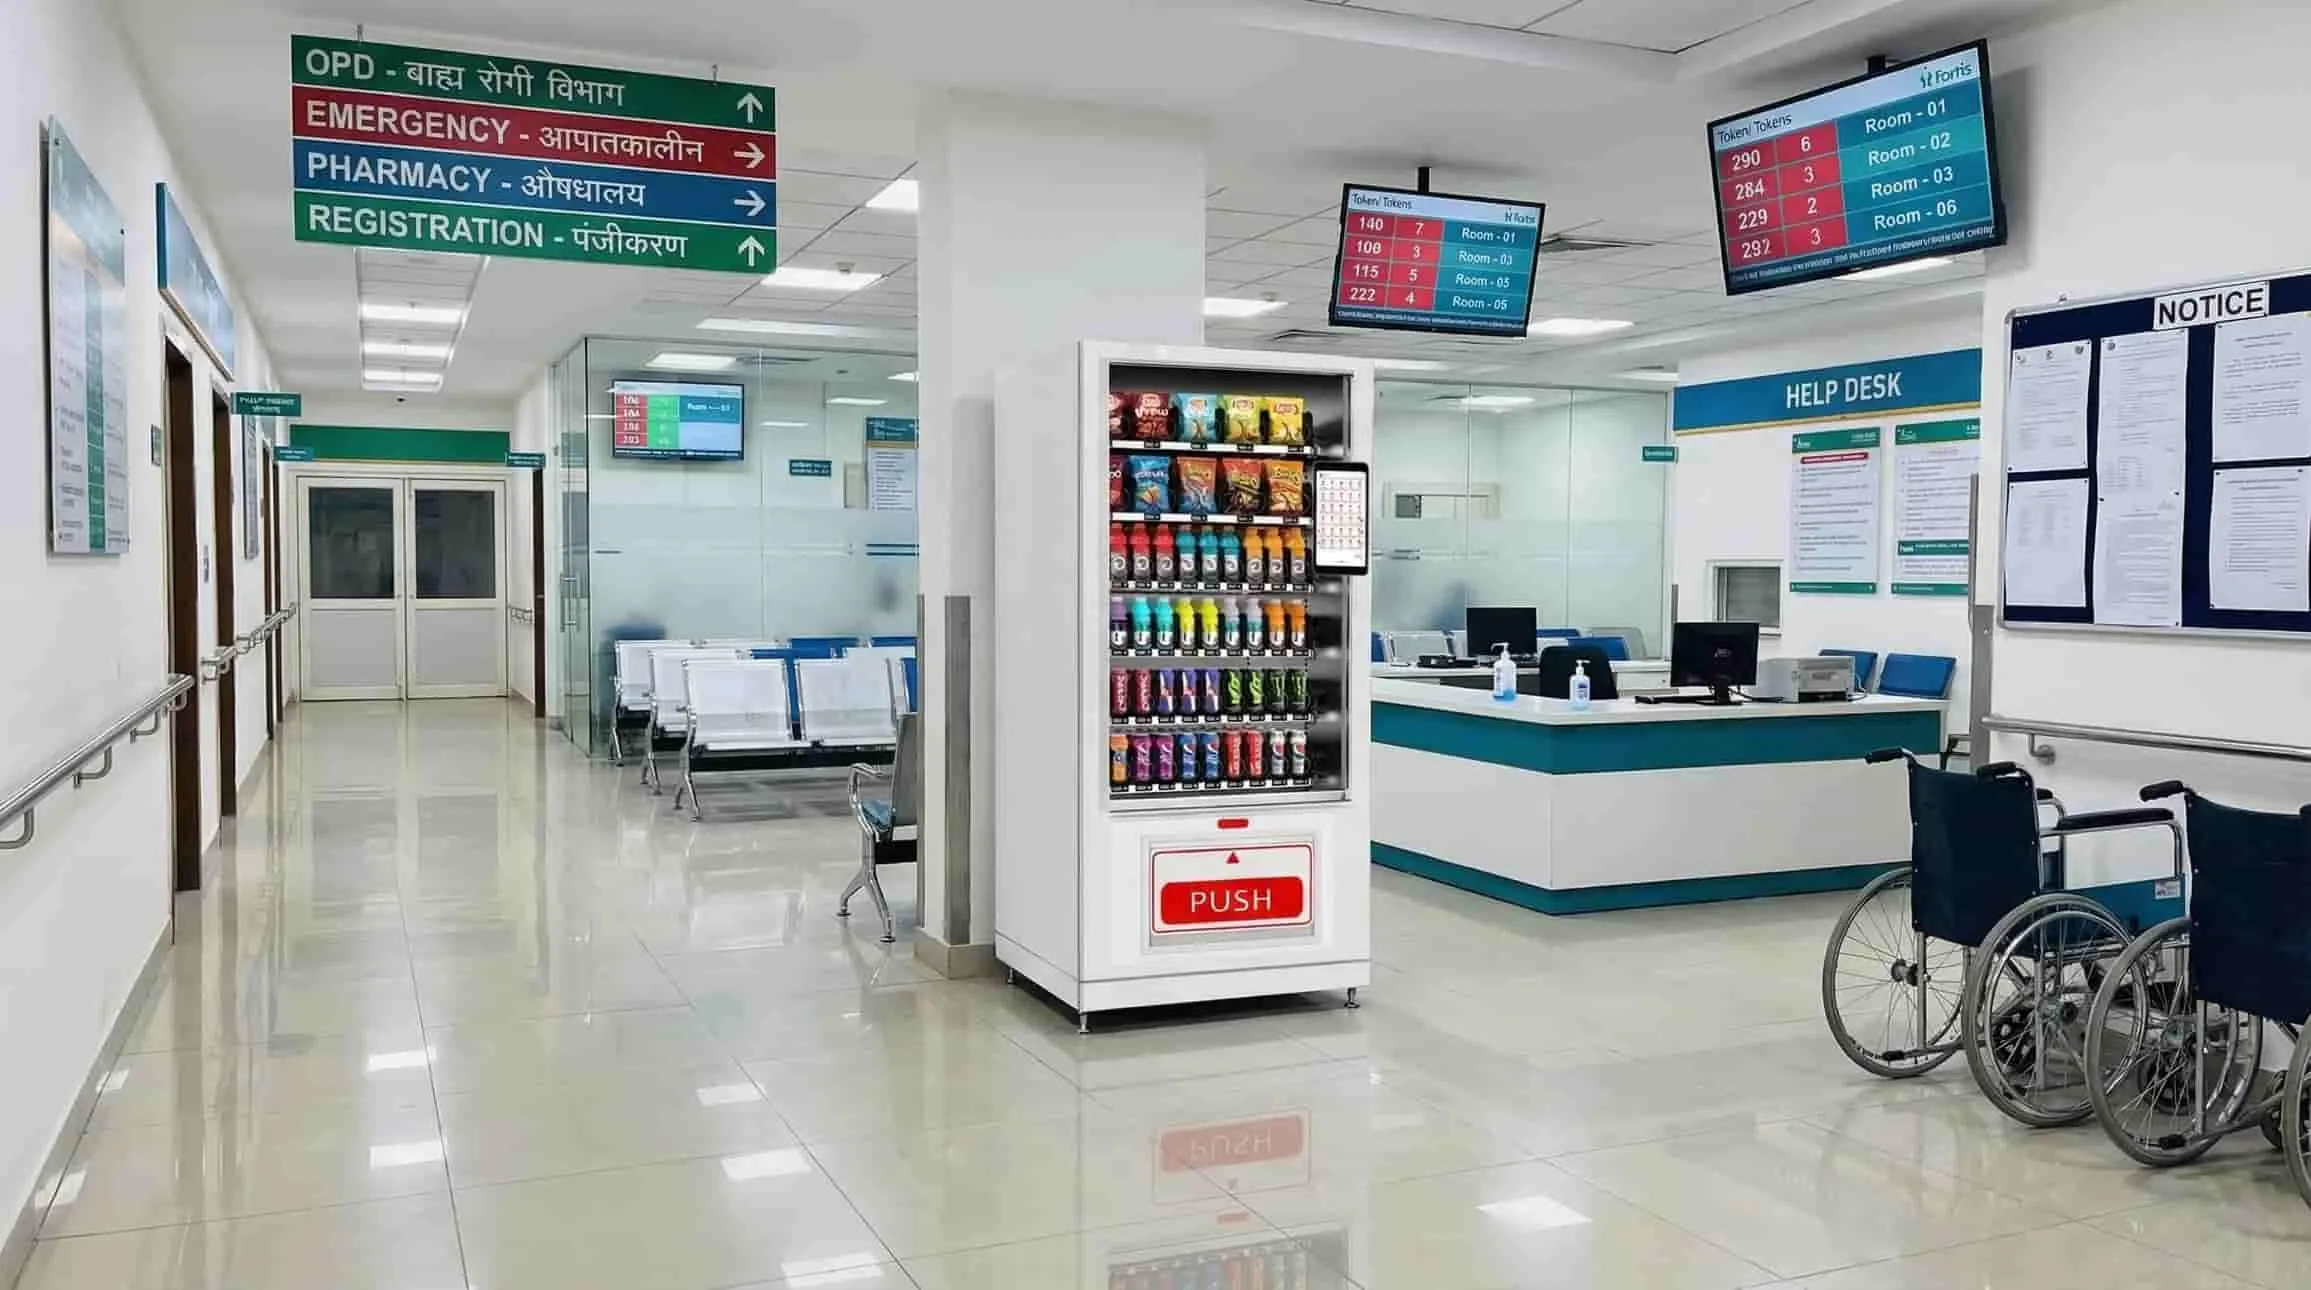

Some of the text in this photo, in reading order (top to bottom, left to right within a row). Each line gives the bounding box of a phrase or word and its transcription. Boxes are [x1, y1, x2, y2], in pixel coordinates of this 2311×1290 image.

[305, 48, 375, 81] OPD
[476, 60, 535, 97] रोगी
[546, 68, 626, 107] विभाग
[306, 99, 511, 146] EMERGENCY
[538, 126, 705, 163] आपातकालीन
[1731, 149, 1761, 171] 290
[1800, 136, 1811, 152] 6
[1865, 113, 1913, 134] Room
[1927, 98, 1947, 117] 01
[1754, 112, 1793, 134] Tokens
[307, 152, 492, 194] PHARMACY
[521, 166, 646, 207] औषधालय
[1735, 179, 1765, 201] 284
[1803, 166, 1815, 184] 3
[1868, 145, 1915, 167] Room
[1930, 131, 1951, 150] 02
[1738, 209, 1769, 230] 229
[1807, 198, 1818, 215] 2
[1871, 178, 1918, 199] Room
[1933, 166, 1953, 185] 03
[309, 205, 543, 250] REGISTRATION
[571, 221, 689, 259] पंजीकरण
[1358, 216, 1384, 231] 140
[1415, 223, 1424, 235] 7
[1461, 227, 1493, 242] Room
[1503, 231, 1516, 244] 01
[1811, 229, 1821, 245] 3
[1874, 211, 1921, 231] Room
[1936, 200, 1957, 217] 06
[1458, 250, 1491, 266] Room
[1455, 273, 1487, 289] Room
[1452, 295, 1485, 311] Room
[2158, 287, 2265, 326] NOTICE
[1786, 371, 1903, 409] HELP DESK
[1190, 888, 1272, 913] PUSH
